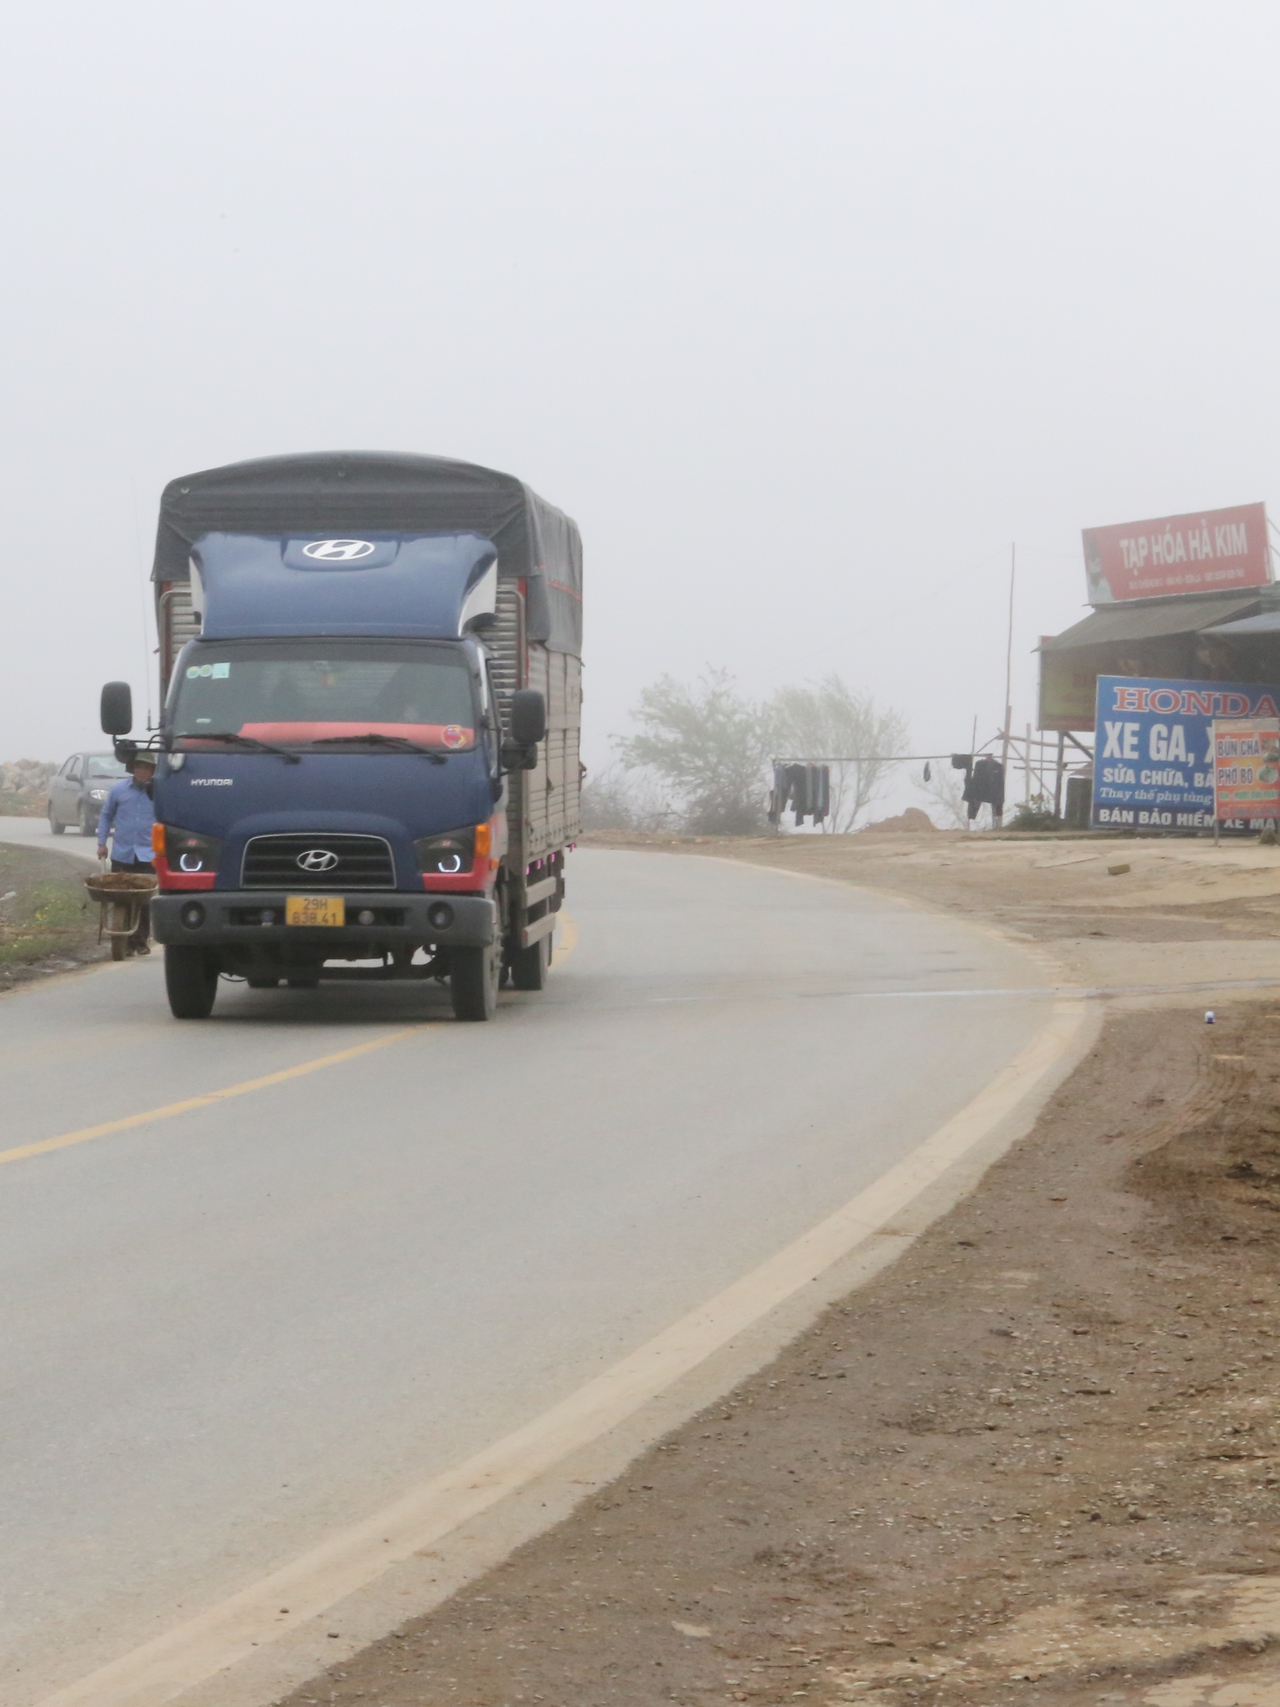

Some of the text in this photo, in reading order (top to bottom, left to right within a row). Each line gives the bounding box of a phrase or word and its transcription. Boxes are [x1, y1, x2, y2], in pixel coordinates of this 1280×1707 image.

[1120, 536, 1149, 575] TẠP
[1151, 523, 1188, 565] HÓA
[1214, 522, 1248, 558] KIM
[1112, 686, 1280, 718] HONDA
[1102, 721, 1140, 760] XE
[1149, 723, 1195, 767] GA,
[1103, 763, 1136, 784] SỬA
[1141, 768, 1189, 788] CHỮA,
[1100, 787, 1132, 801] Thay
[1135, 788, 1157, 800] thế
[1156, 790, 1180, 803] phụ
[1099, 807, 1134, 823] BÁN
[1139, 808, 1172, 825] BẢO
